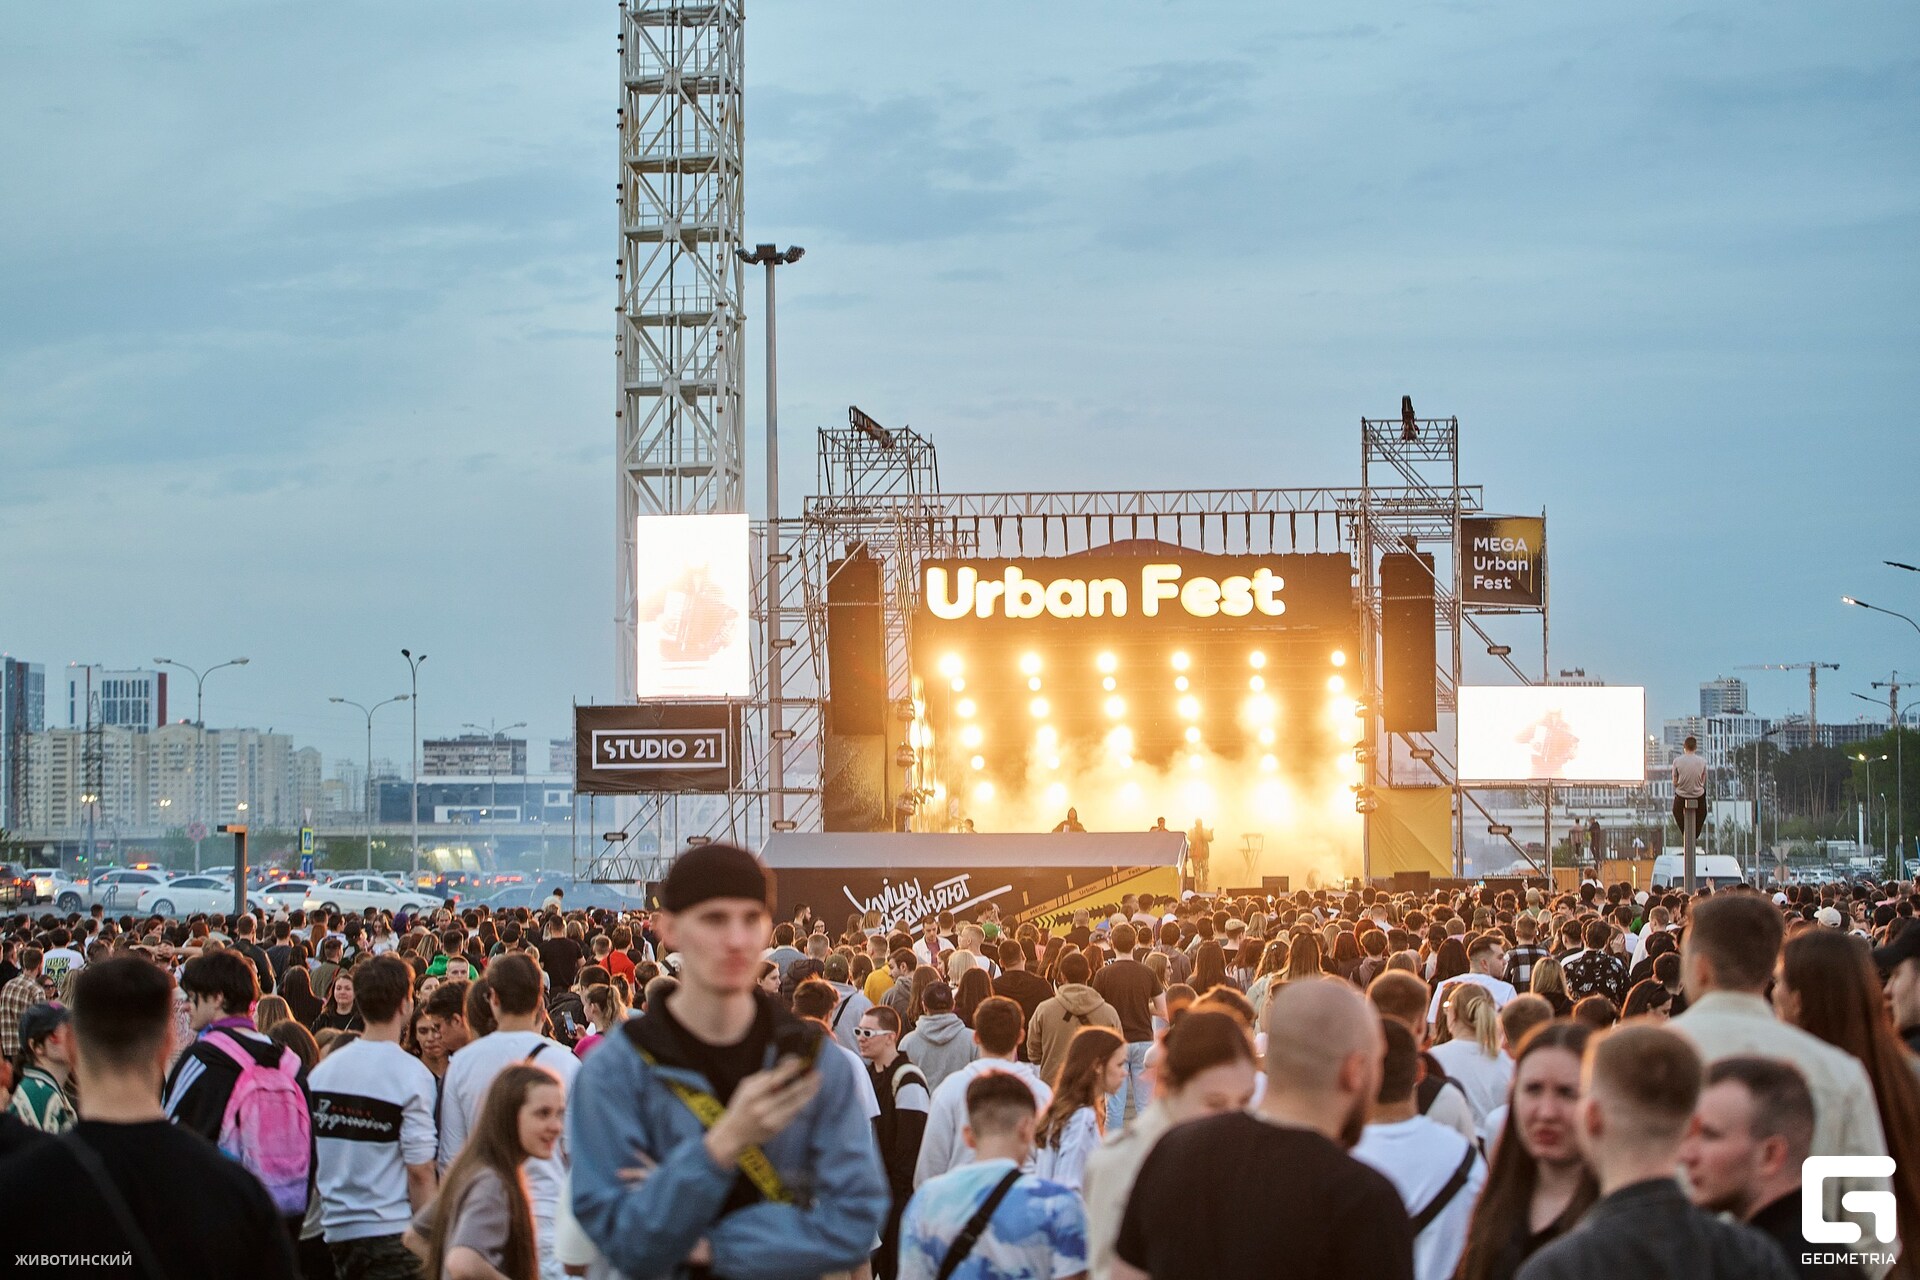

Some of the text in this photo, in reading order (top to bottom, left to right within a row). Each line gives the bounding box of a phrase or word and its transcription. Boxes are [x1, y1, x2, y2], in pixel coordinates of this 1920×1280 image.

[1473, 537, 1528, 552] MEGA
[1473, 556, 1529, 571] Urban
[926, 563, 1286, 619] Urban Fest
[1473, 575, 1512, 590] Fest
[603, 738, 715, 760] STUDIO 21
[1029, 904, 1048, 916] MEGA
[1079, 885, 1098, 896] Urban
